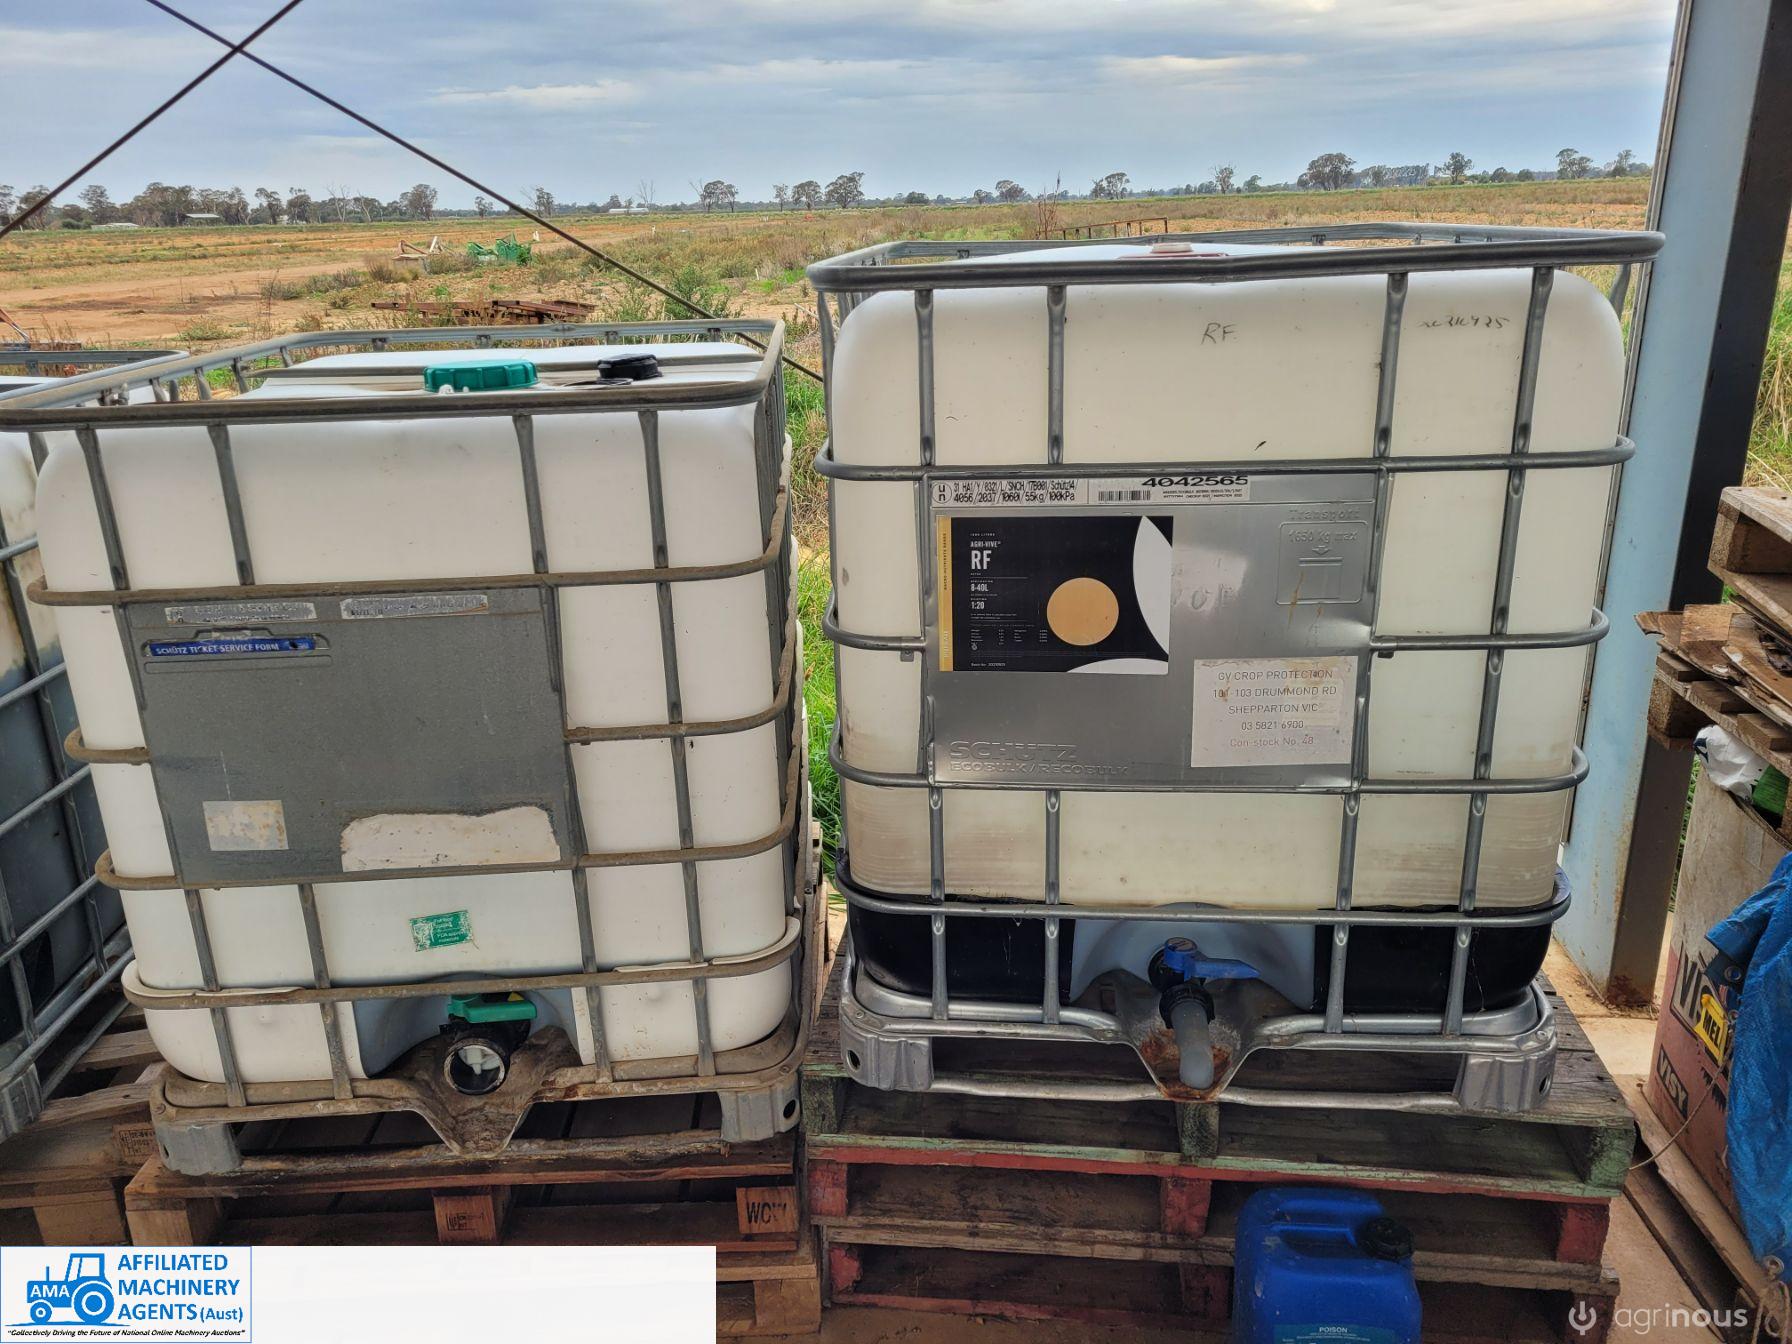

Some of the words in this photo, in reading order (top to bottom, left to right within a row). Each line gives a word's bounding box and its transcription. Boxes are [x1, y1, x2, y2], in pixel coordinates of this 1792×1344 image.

[1201, 323, 1237, 344] RF
[1141, 476, 1249, 488] 4042565
[971, 550, 992, 570] RF
[970, 583, 989, 592] 8-40L
[971, 601, 985, 610] 1:20
[255, 643, 280, 651] FORM
[1218, 671, 1232, 681] GV
[1234, 670, 1263, 680] CROP
[1254, 686, 1319, 697] DRUMMOND
[1322, 686, 1337, 696] RD
[1228, 705, 1299, 715] SHEPPARTON
[1301, 703, 1319, 712] VIC
[1241, 721, 1253, 731] 03
[1255, 720, 1278, 730] 5821
[1281, 720, 1304, 730] 6900
